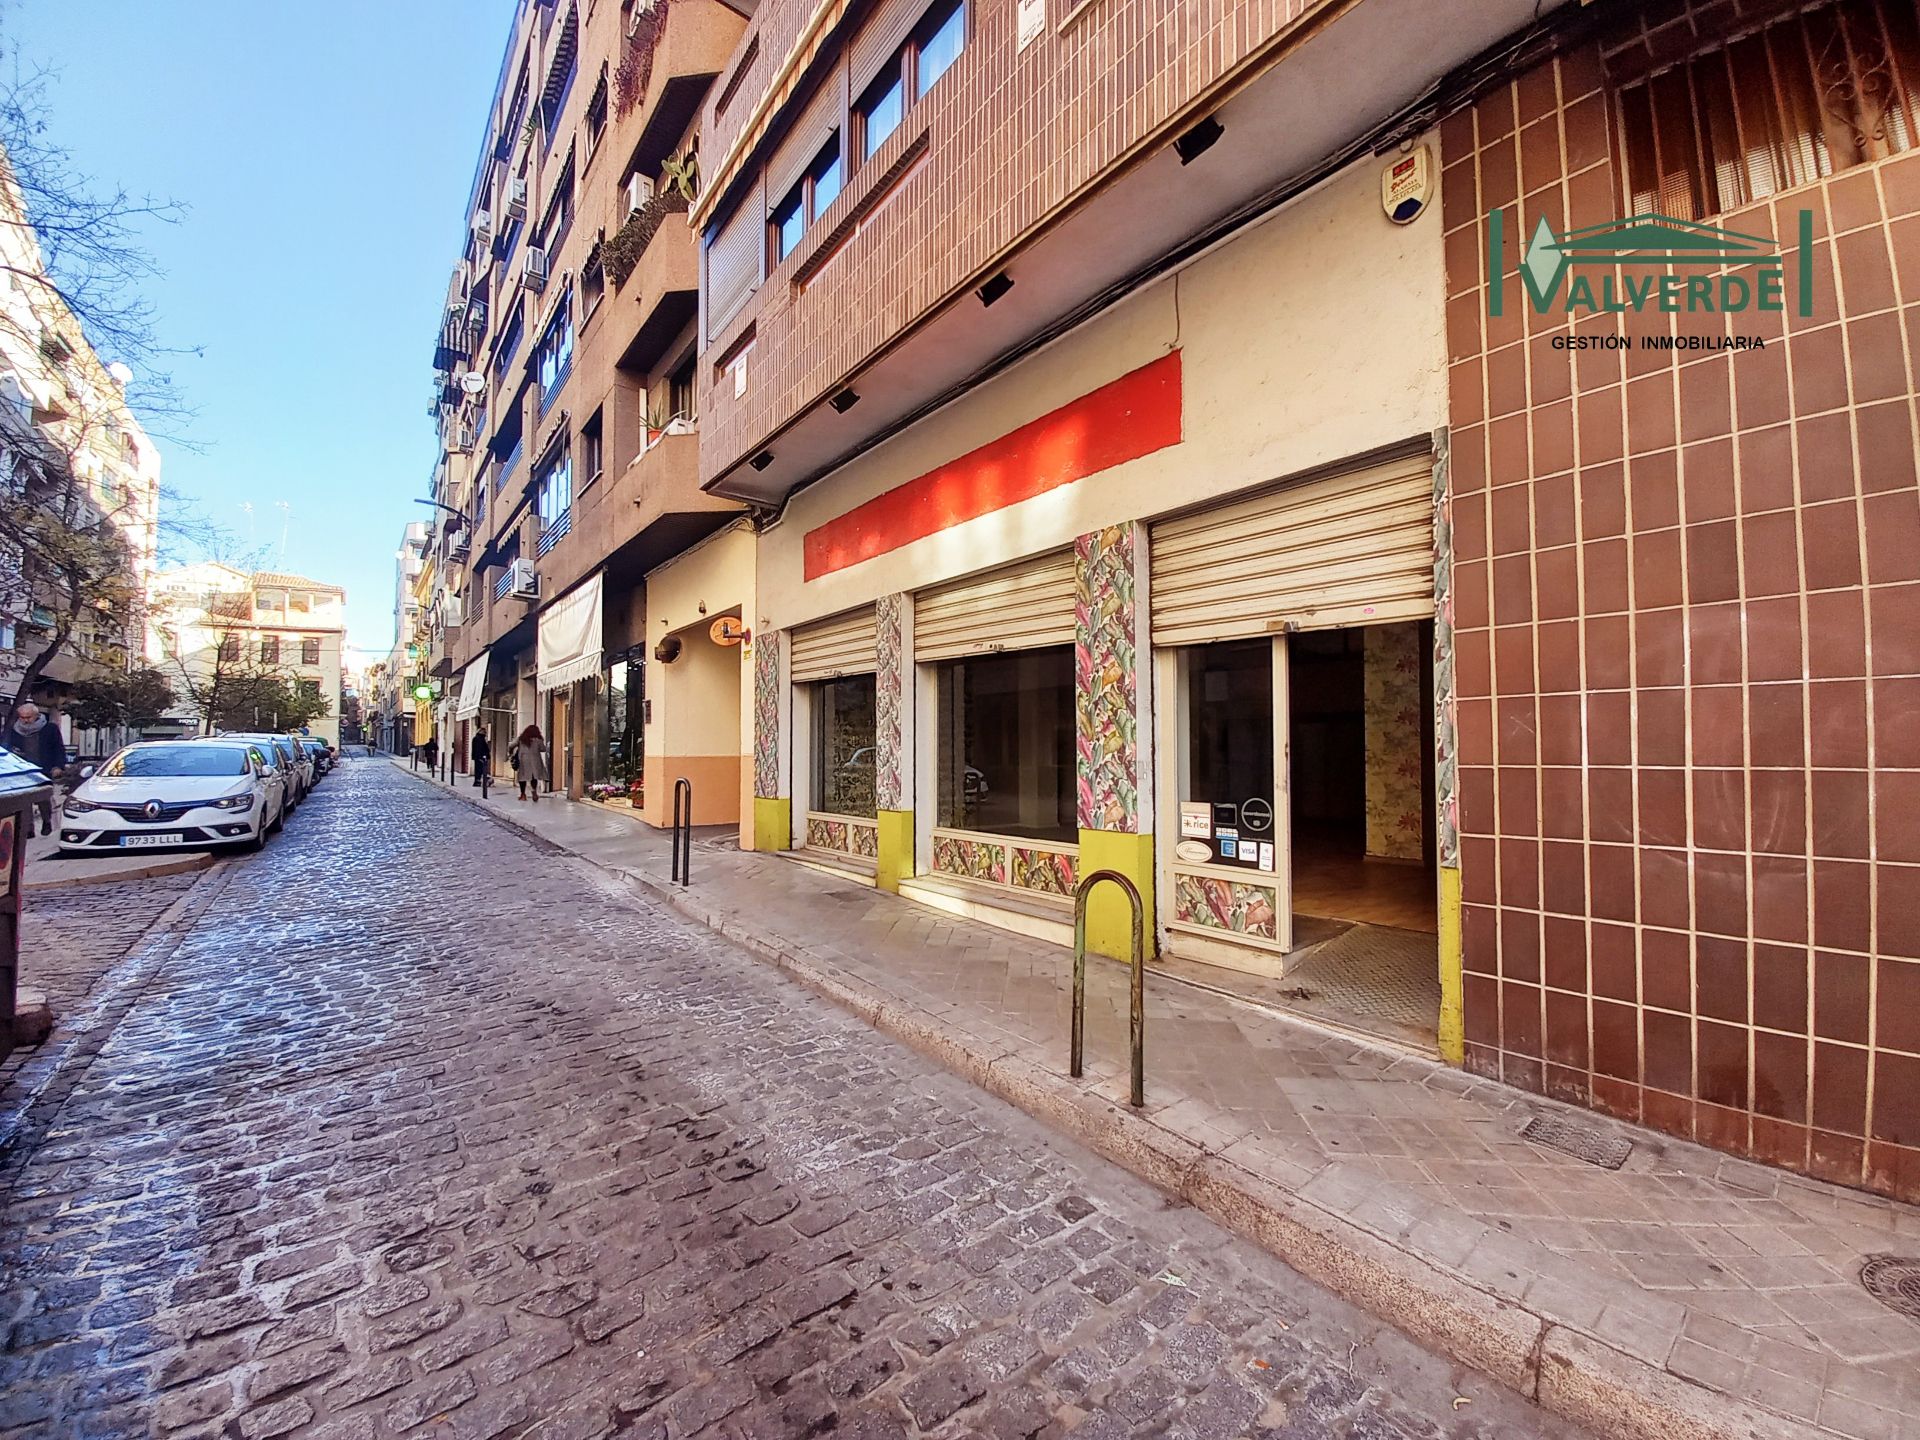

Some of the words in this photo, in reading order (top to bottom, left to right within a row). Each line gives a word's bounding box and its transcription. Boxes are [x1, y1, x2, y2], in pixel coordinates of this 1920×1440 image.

[127, 836, 156, 846] 9733
[159, 835, 181, 844] LLL
[1241, 847, 1256, 855] VISA
